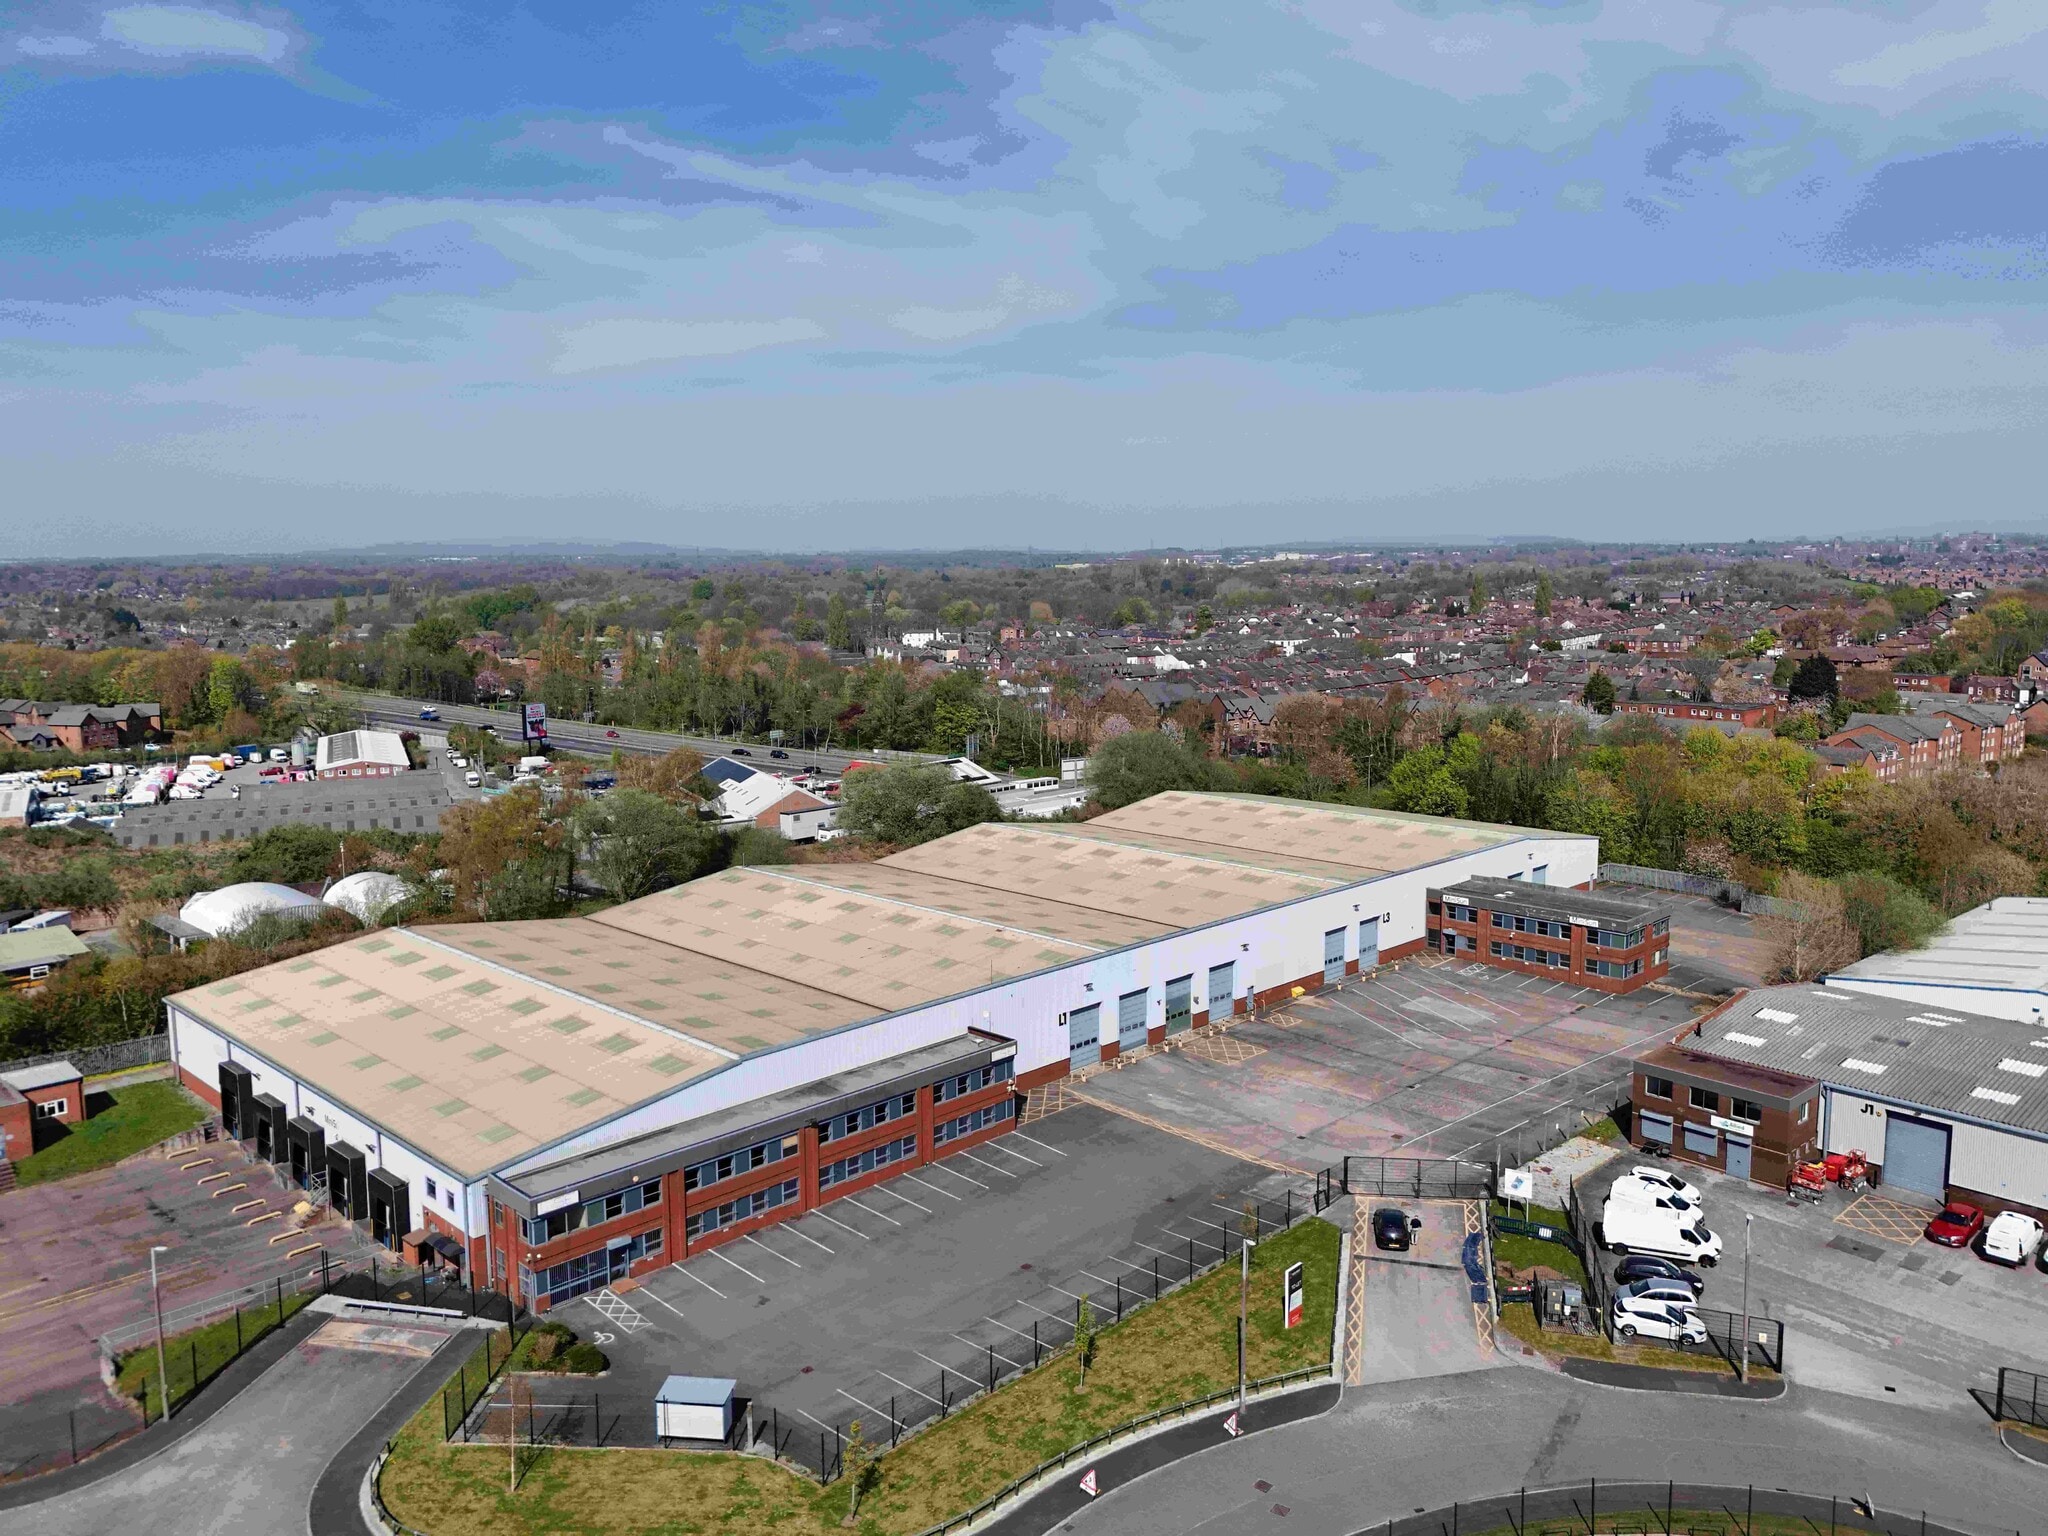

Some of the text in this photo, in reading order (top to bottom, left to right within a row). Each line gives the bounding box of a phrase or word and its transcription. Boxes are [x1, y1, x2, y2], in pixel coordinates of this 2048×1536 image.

[1382, 912, 1391, 923] L3
[1058, 1011, 1067, 1026] L1
[1860, 1103, 1874, 1115] J1
